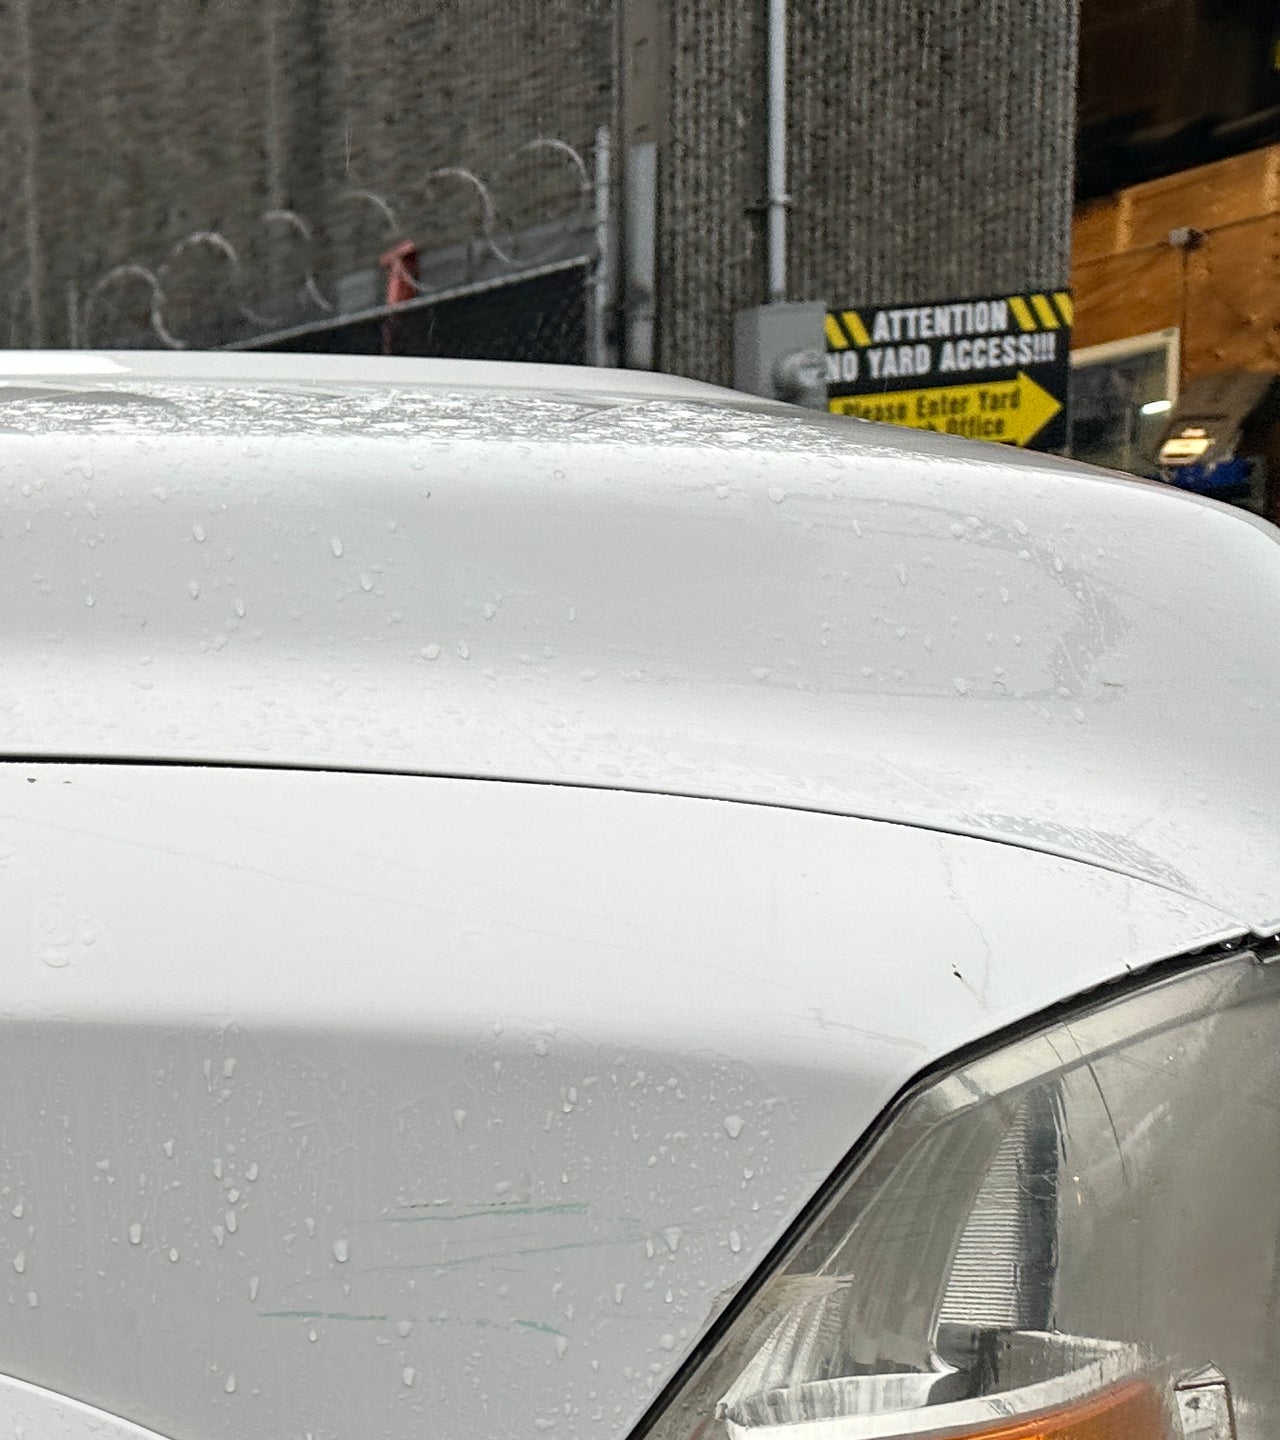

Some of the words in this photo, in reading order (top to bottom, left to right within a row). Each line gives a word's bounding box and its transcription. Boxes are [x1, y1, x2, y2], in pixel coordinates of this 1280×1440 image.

[873, 300, 1009, 343] ATTENTION
[826, 350, 859, 383] NO
[867, 344, 932, 379] YARD
[941, 333, 1057, 372] ACCESS!!!
[916, 394, 971, 419] Enter
[978, 387, 1021, 411] Yard
